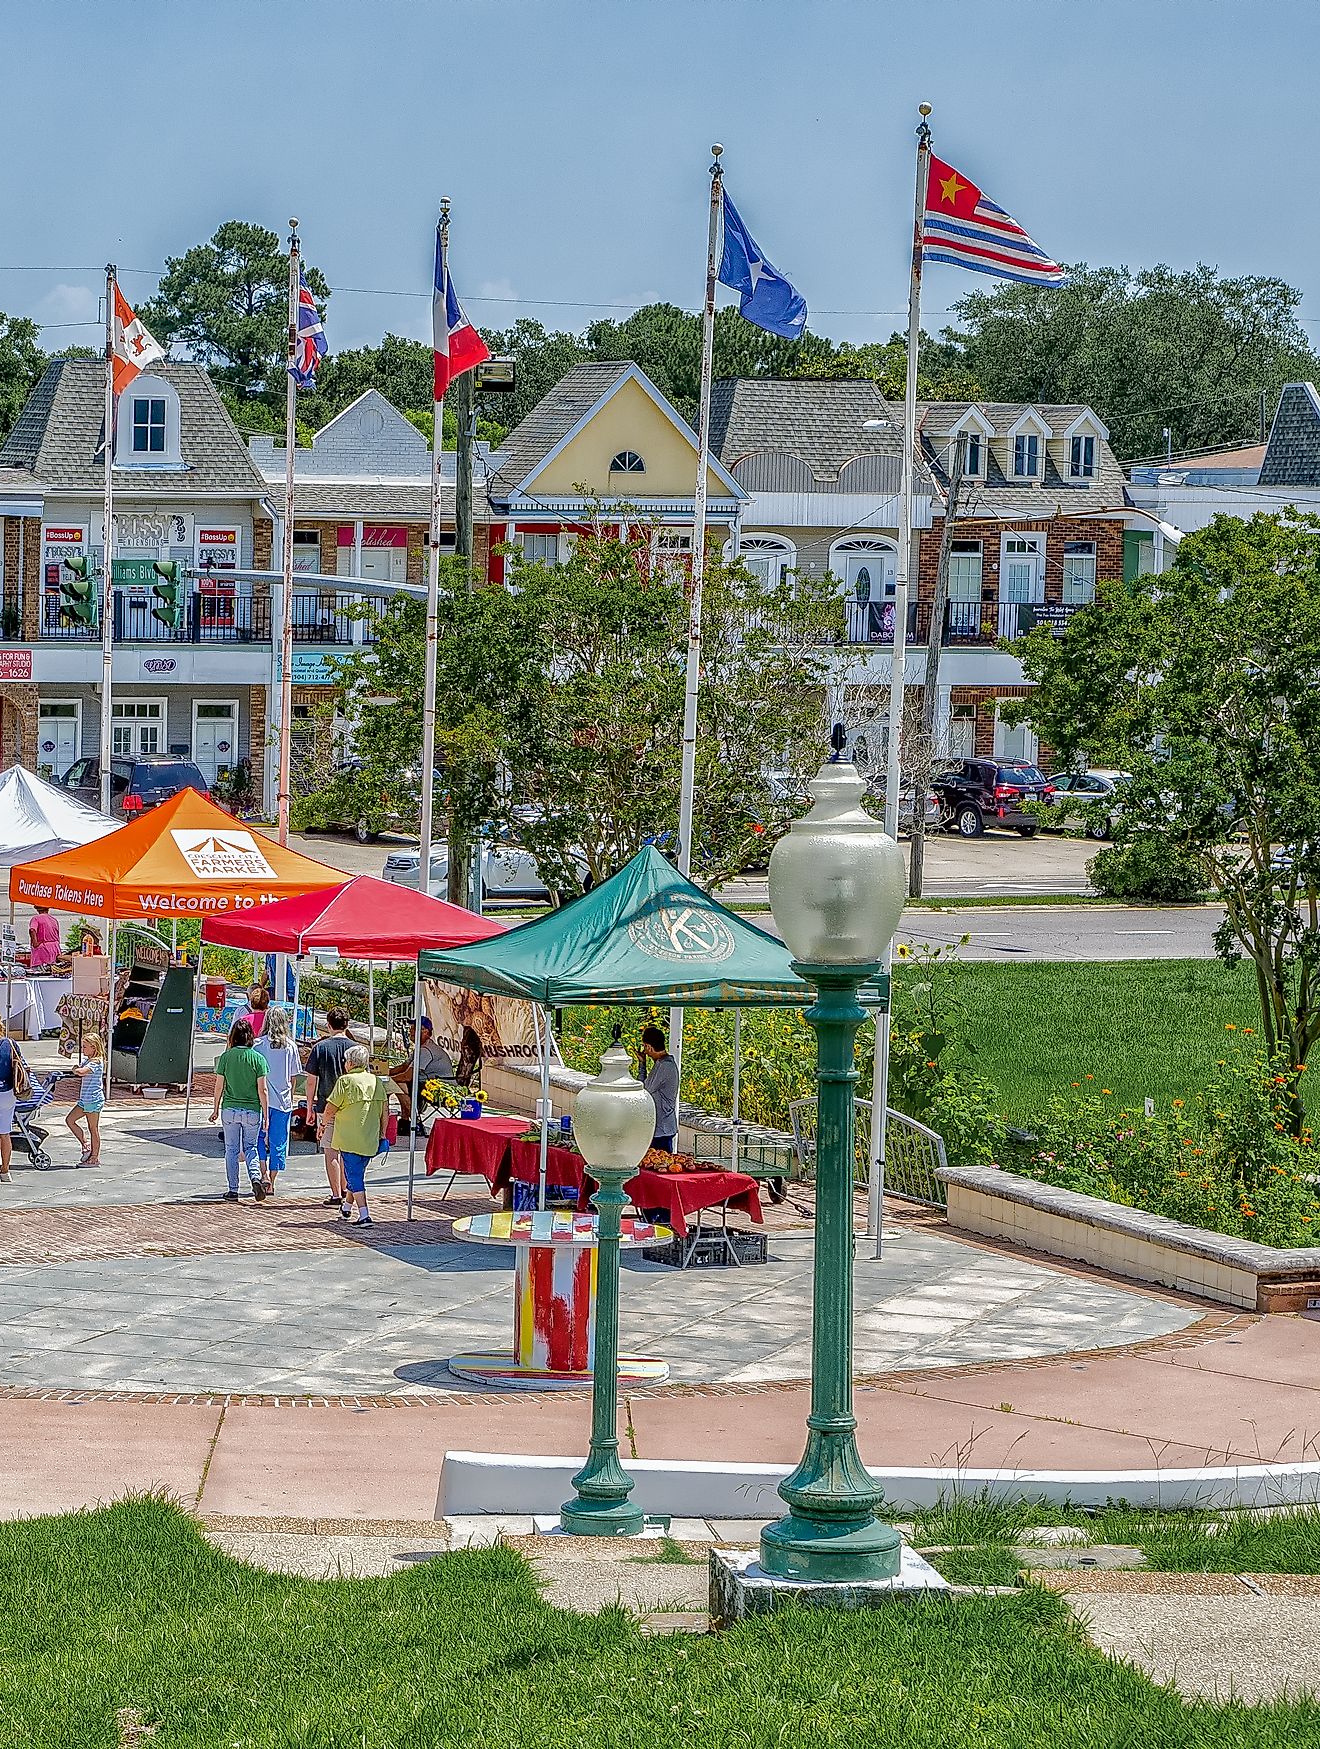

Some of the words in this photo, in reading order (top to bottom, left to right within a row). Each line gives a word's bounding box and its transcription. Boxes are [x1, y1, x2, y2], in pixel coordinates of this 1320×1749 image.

[117, 514, 173, 539] BOSSY
[350, 528, 397, 546] olished
[113, 565, 137, 580] illiams
[2, 652, 14, 660] FOR
[14, 652, 26, 660] FUN
[12, 660, 31, 668] STUDIO
[190, 858, 265, 867] FARMERS
[195, 866, 267, 874] MARKET
[18, 879, 53, 899] Purchase
[54, 884, 82, 904] Tokens
[83, 888, 104, 907] Here
[138, 893, 229, 910] Welcome
[234, 894, 255, 909] to
[436, 1035, 461, 1052] GOUR
